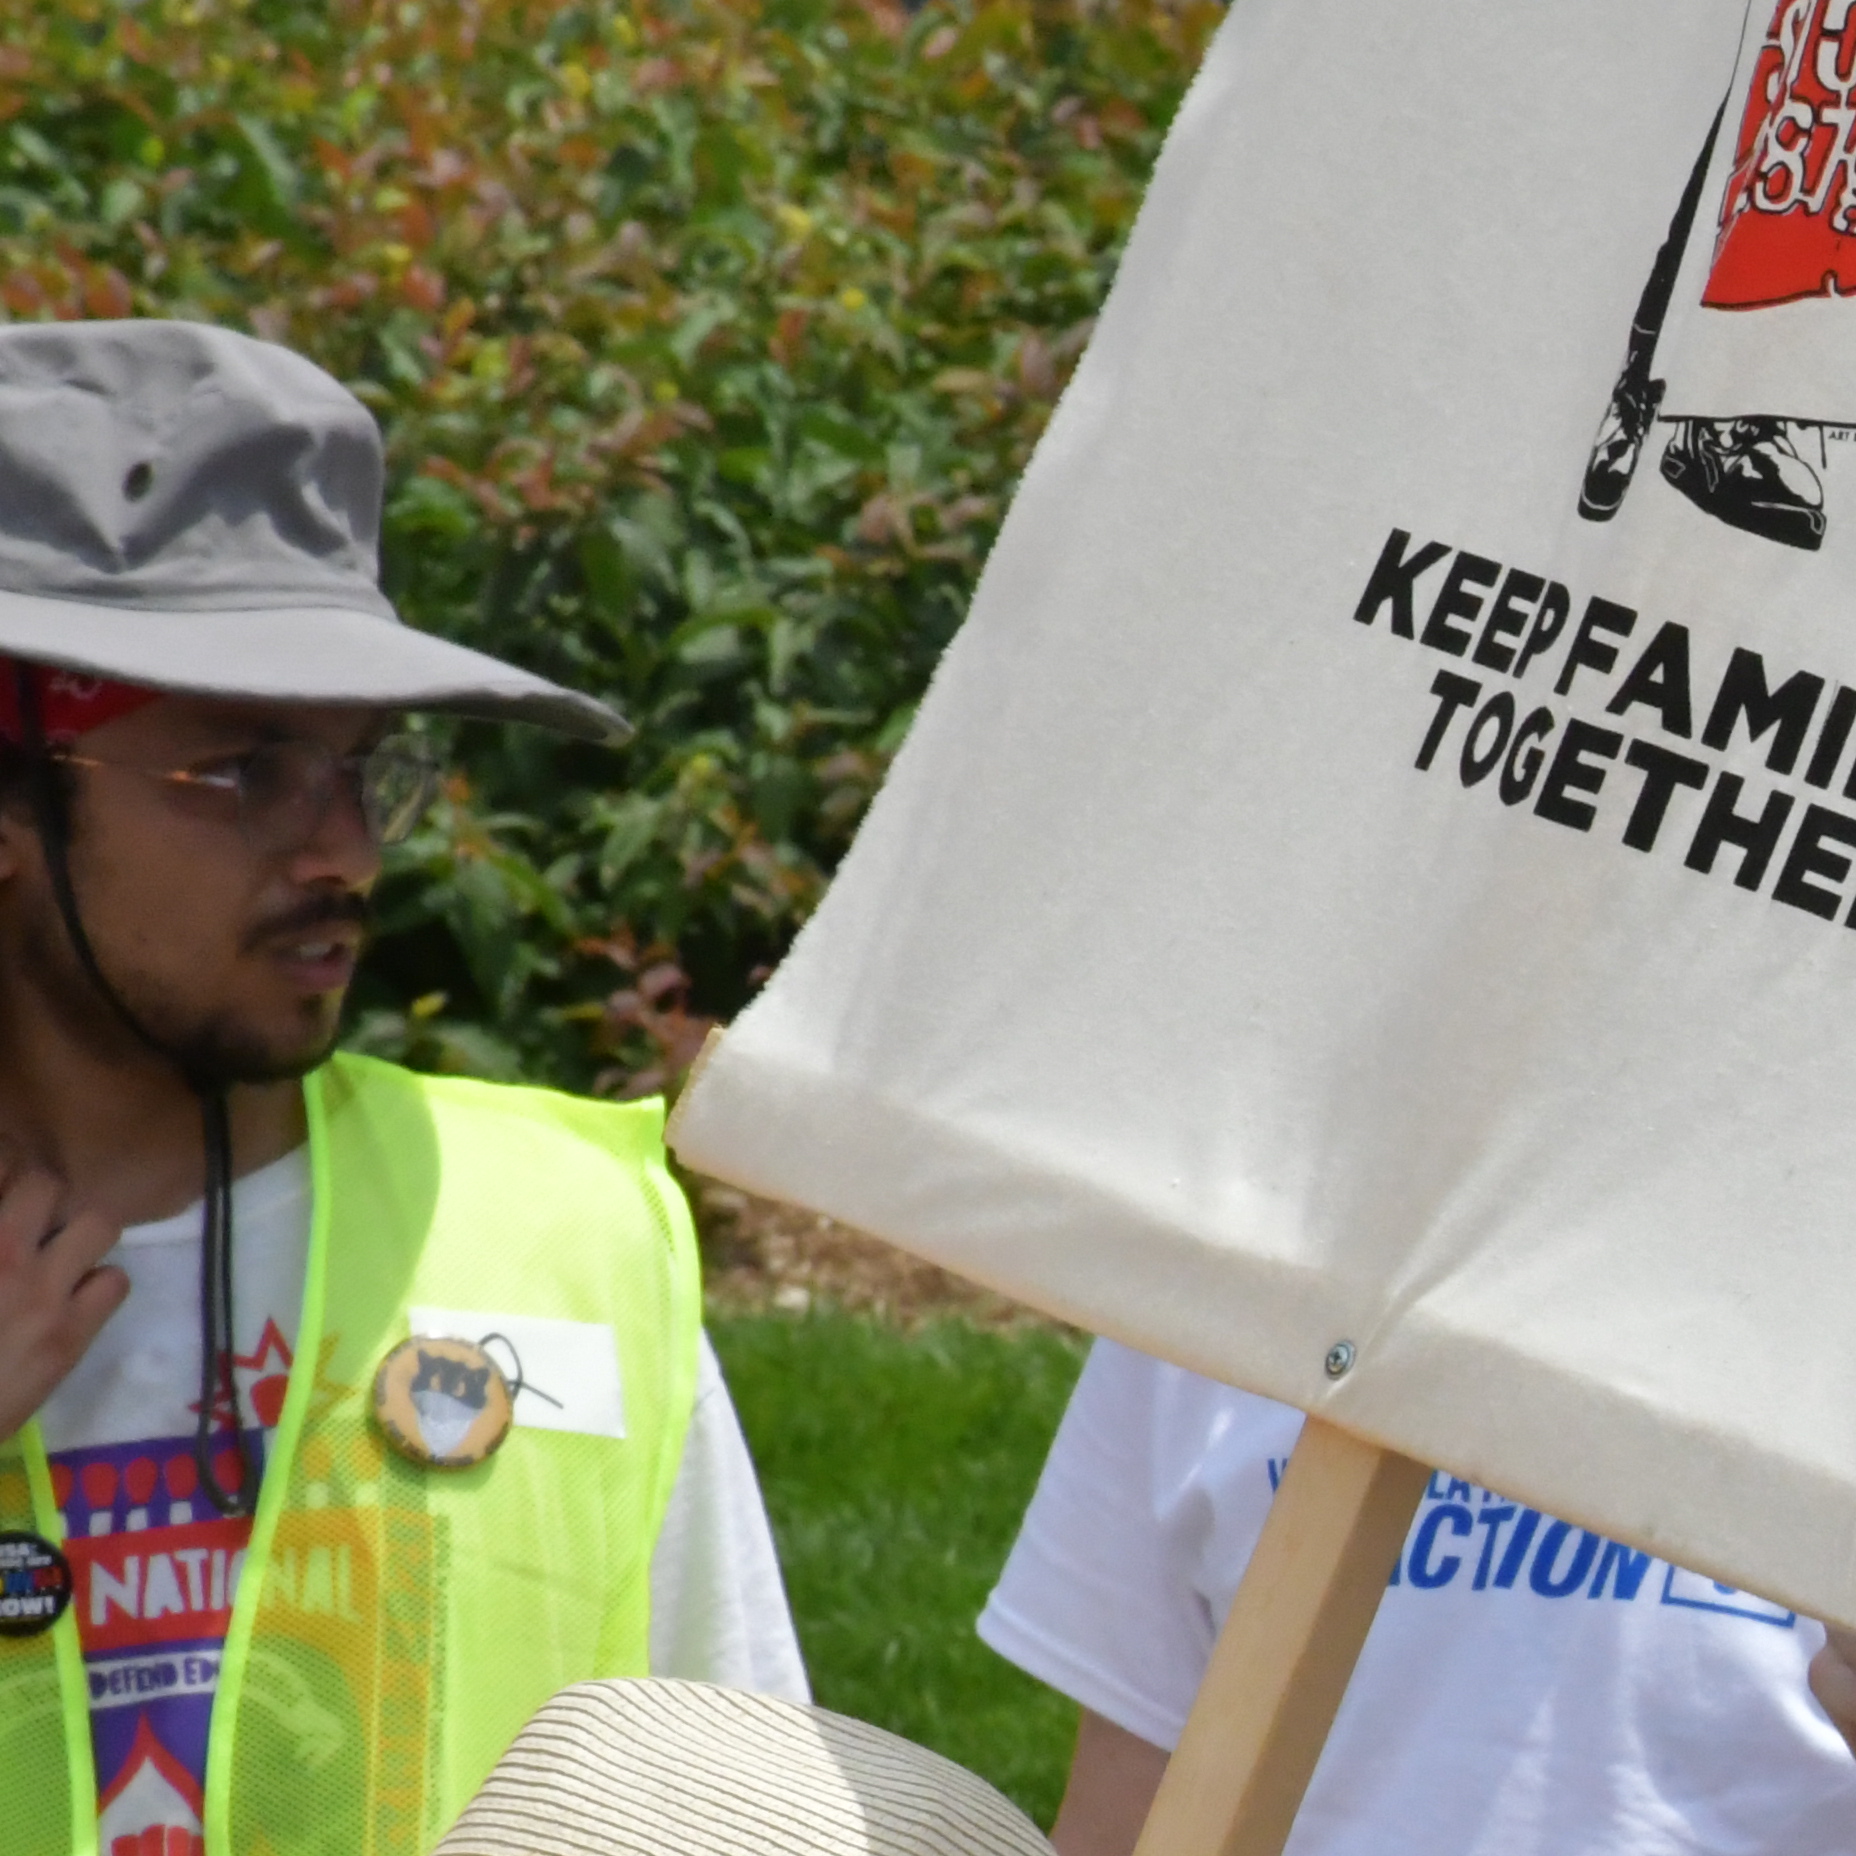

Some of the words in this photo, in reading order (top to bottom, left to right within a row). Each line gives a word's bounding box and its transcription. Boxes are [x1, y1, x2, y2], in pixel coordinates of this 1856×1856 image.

[1354, 527, 1570, 680] KEEP
[1388, 1504, 1653, 1602] CTION
[0, 1596, 55, 1617] OW!
[89, 1662, 178, 1699] DEFEND
